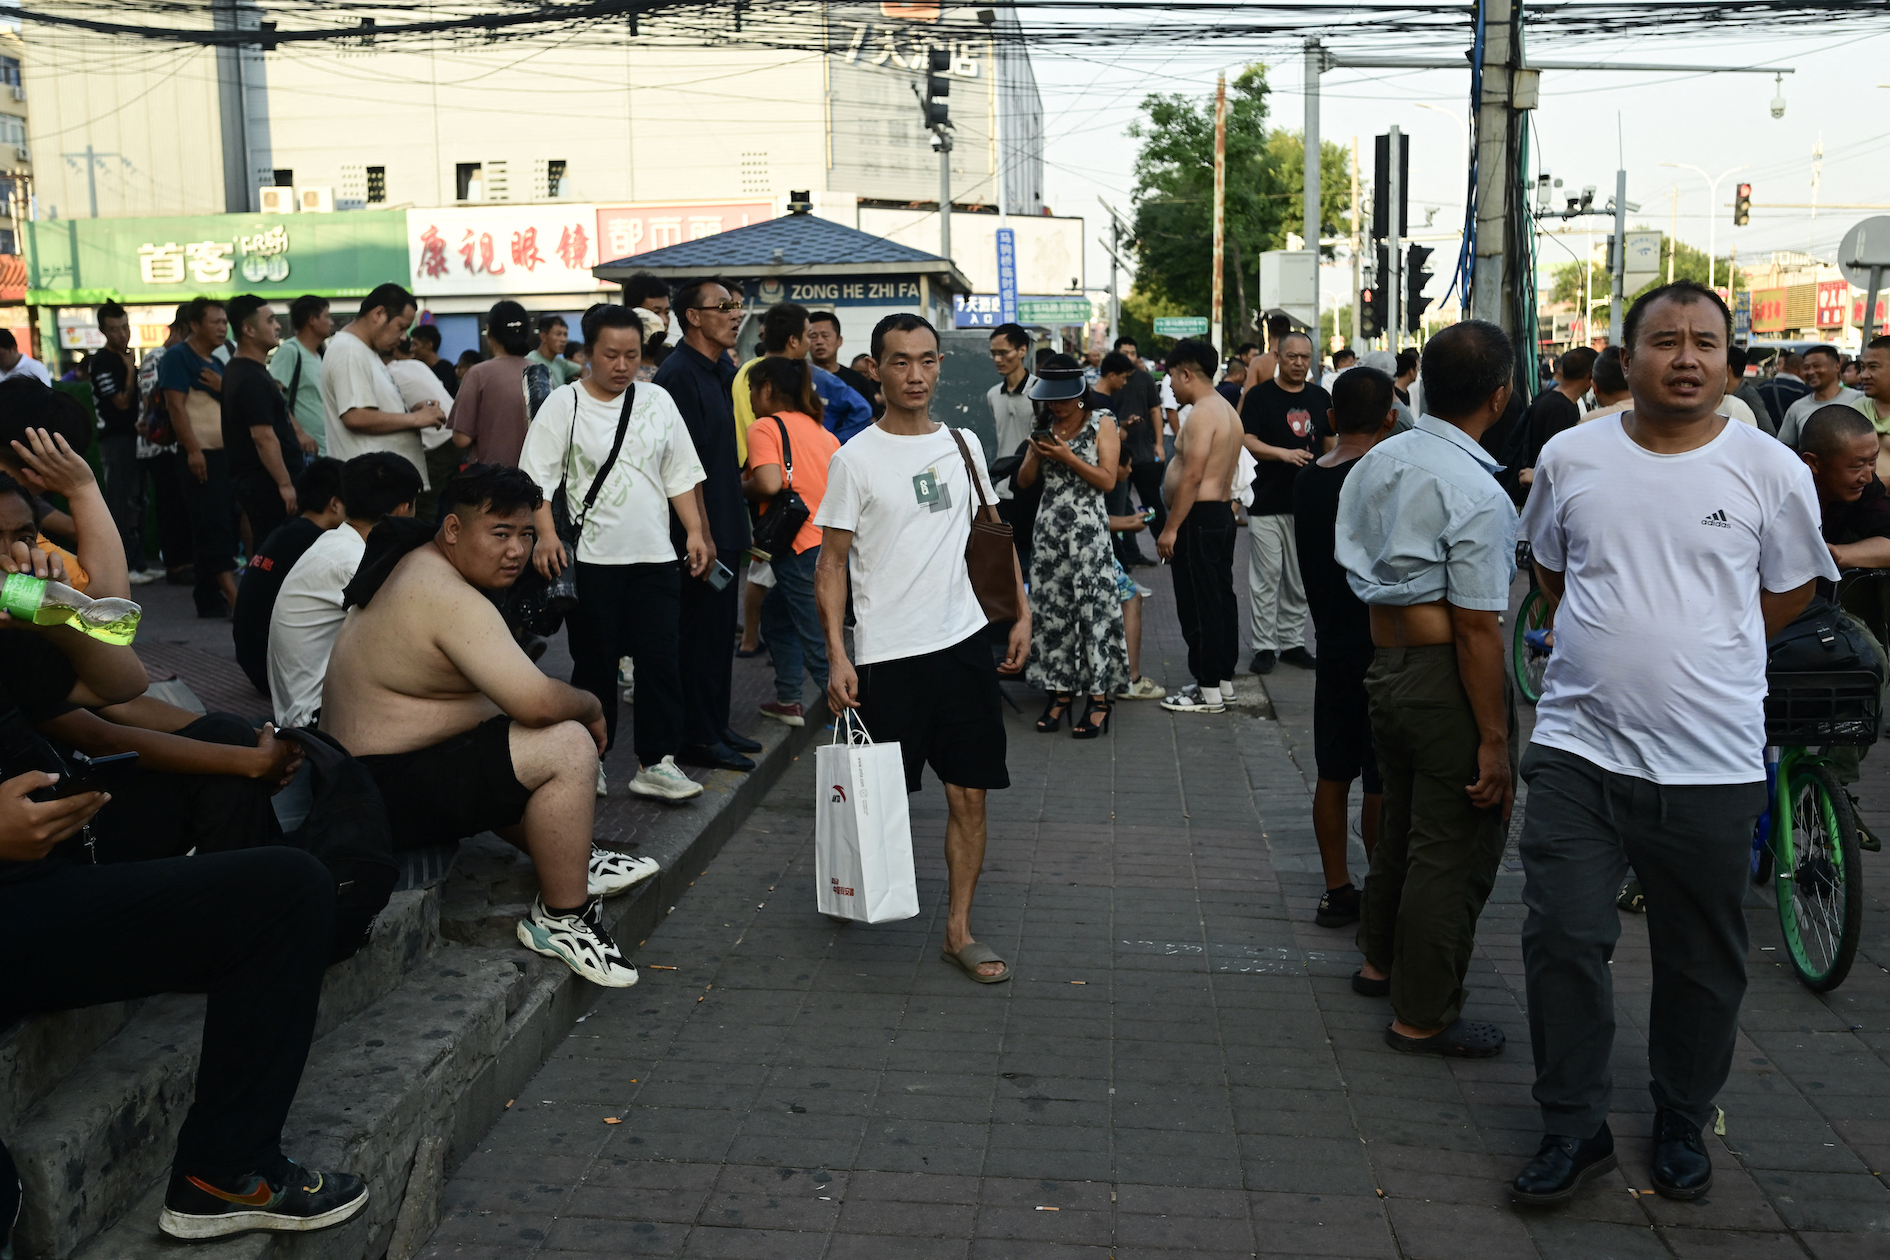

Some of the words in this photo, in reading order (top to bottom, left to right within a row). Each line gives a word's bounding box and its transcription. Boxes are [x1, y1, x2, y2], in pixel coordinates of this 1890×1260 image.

[608, 213, 749, 256] 都市丽
[137, 241, 236, 284] 首客
[417, 224, 597, 279] 康视眼镜
[791, 284, 839, 300] ZONG
[843, 284, 864, 299] HE
[868, 283, 894, 298] ZHI
[898, 283, 920, 298] FA
[970, 313, 993, 325] 入口
[1701, 519, 1731, 529] adidas
